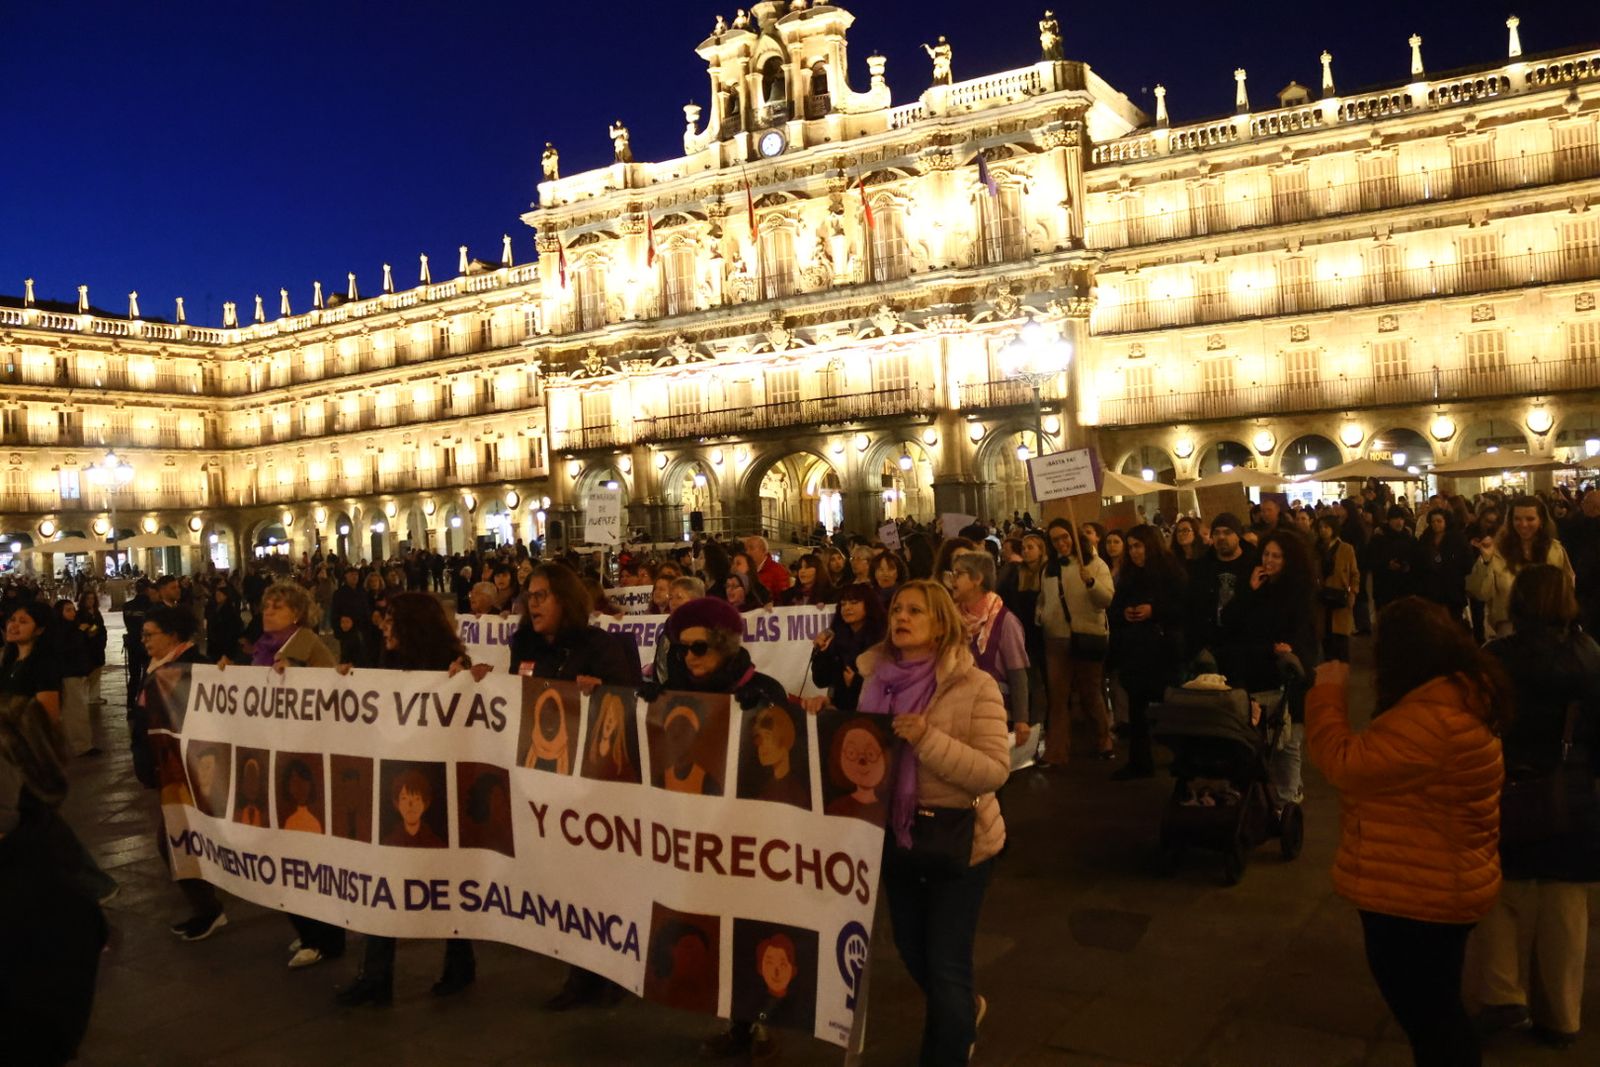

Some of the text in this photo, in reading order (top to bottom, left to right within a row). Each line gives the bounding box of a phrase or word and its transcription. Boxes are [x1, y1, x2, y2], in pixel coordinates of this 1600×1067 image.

[460, 621, 480, 645] EN
[743, 616, 781, 643] LAS
[193, 682, 507, 733] NOS QUEREMOS VIVAS
[528, 800, 870, 906] Y CON DERECHOS
[281, 857, 396, 911] FEMINISTA
[404, 879, 451, 911] DE
[458, 879, 641, 962] SALAMANCA
